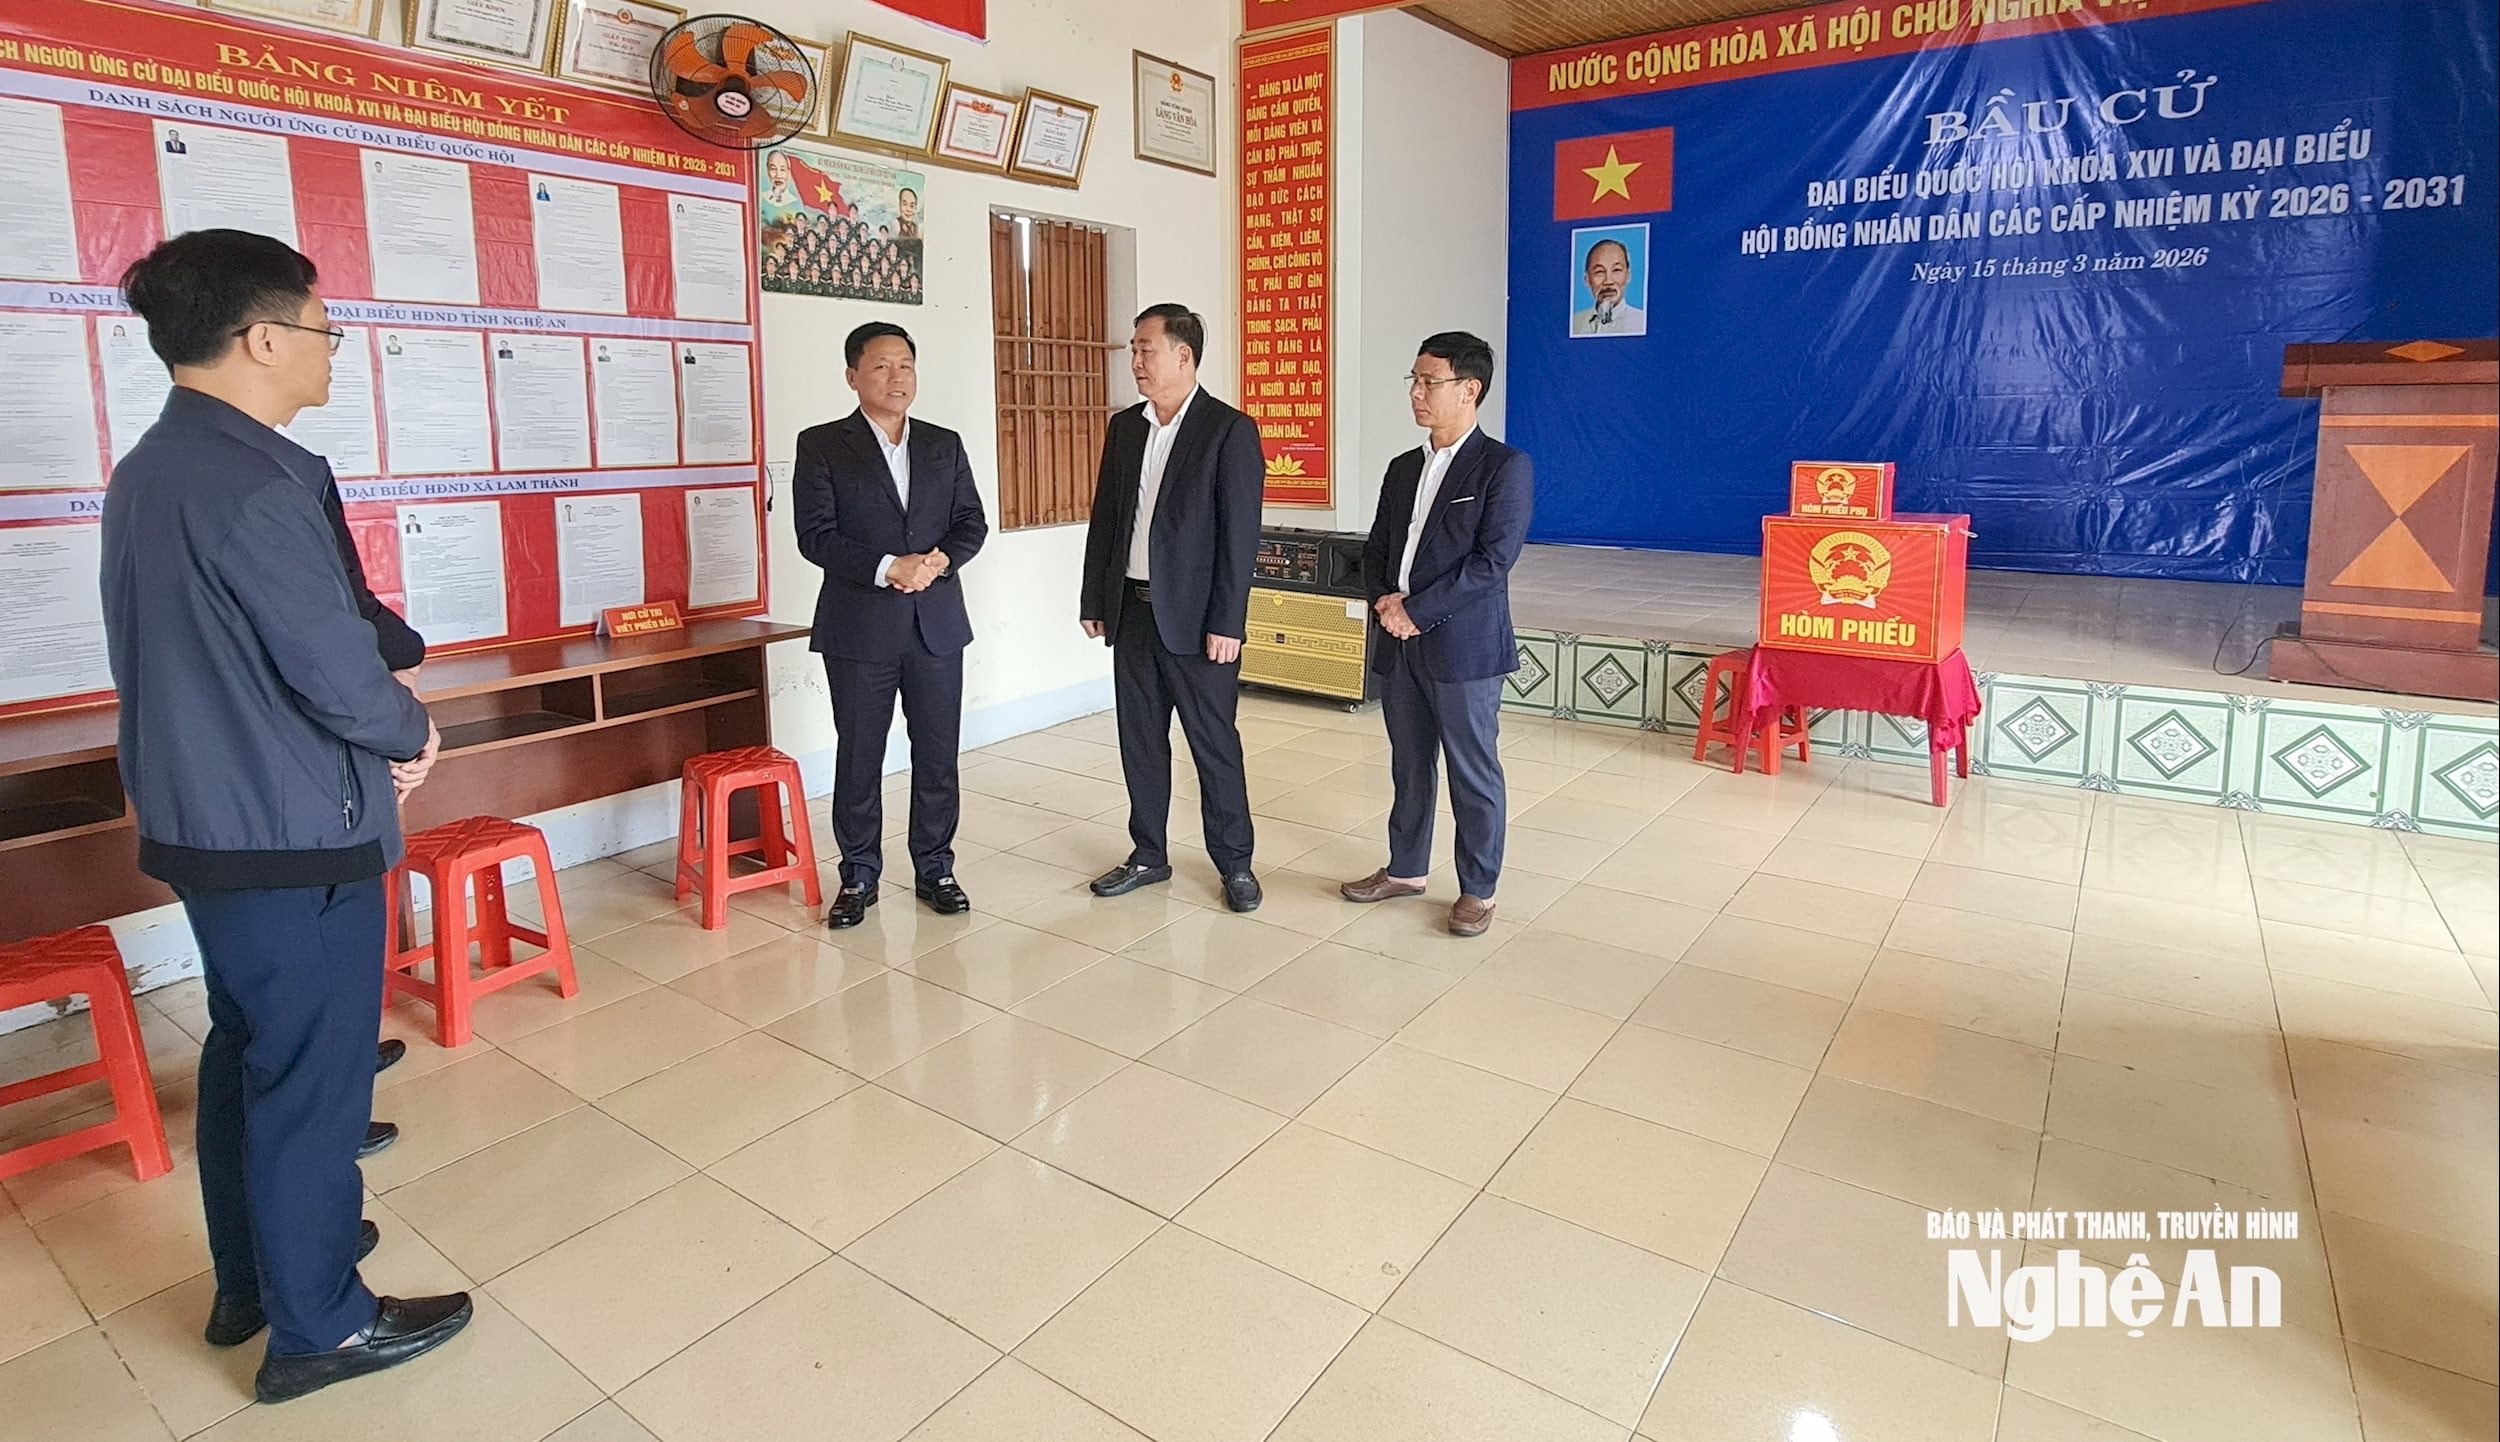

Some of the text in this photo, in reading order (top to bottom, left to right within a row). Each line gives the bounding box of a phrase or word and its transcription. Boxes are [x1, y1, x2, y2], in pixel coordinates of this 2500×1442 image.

[1548, 51, 1618, 92] NƯỚC
[1626, 41, 1701, 84] CỘNG
[1709, 26, 1768, 69] HÒA
[1776, 15, 1818, 58] XÃ
[1827, 6, 1881, 53] HỘI
[215, 43, 570, 125] BẢNG NIÊM YẾT
[1259, 71, 1324, 98] ĐẢNG TA LÀ MỘT
[24, 42, 84, 70] NGƯỜI
[89, 50, 128, 78] ỨNG
[133, 58, 157, 82] CỬ
[162, 66, 190, 90] ĐẠI
[195, 68, 233, 95] BIỂU
[238, 78, 279, 102] QUỐC
[284, 86, 310, 110] HỘI
[357, 99, 379, 118] XVI
[382, 102, 402, 122] VÀ
[404, 107, 427, 128] ĐẠI
[430, 109, 461, 131] BIỂU
[463, 116, 485, 138] HỘI
[487, 119, 521, 142] ĐỒNG
[523, 126, 557, 149] NHÂN
[559, 132, 583, 153] DÂN
[585, 136, 609, 157] CÁC
[610, 140, 631, 160] CẤP
[632, 147, 666, 169] NHIỆM
[668, 152, 681, 169] KỲ
[682, 156, 707, 173] 2026
[714, 162, 736, 178] 2031
[1246, 103, 1267, 123] ĐẢNG
[1922, 68, 2218, 145] BẦU CỬ
[88, 88, 151, 109] DANH
[157, 98, 213, 118] SÁCH
[219, 104, 283, 129] NGƯỜI
[289, 116, 328, 136] ỨNG
[333, 124, 358, 139] CỬ
[397, 134, 436, 151] BIỂU
[440, 139, 484, 159] QUỐC
[487, 148, 515, 164] HỘI
[1264, 115, 1323, 141] ĐẢNG VIÊN VÀ
[1246, 139, 1323, 165] CÁN BỘ PHẢI THỰC
[1246, 170, 1258, 189] SỰ
[1263, 164, 1286, 185] THẤM
[1807, 118, 2373, 212] ĐẠI BIỂU QUỐC HỘI KHÓA XVI VÀ ĐẠI BIỂU
[1246, 183, 1323, 210] ĐẠO ĐỨC CÁCH
[1246, 206, 1324, 231] MẠNG, THẬT SỰ
[1741, 173, 2466, 259] HỘI ĐỒNG NHÂN DÂN CÁC CẤP NHIỆM KỲ 2026 2031
[1270, 227, 1323, 250] KIỆM, LIÊM,
[1247, 249, 1323, 271] CHÍNH, CHÍ CÔNG VÔ
[1910, 247, 2210, 283] Ngày 15 tháng 3 năm 2026
[1263, 271, 1323, 291] PHẢI GIỮ GÌN
[49, 291, 113, 306] DANH
[1247, 292, 1323, 313] ĐẢNG TA THẬT
[331, 305, 360, 319] ĐẠI
[366, 304, 406, 320] BIỂU
[461, 310, 498, 325] TỈNH
[503, 314, 544, 329] NGHỆ
[547, 319, 567, 328] AN
[1247, 312, 1322, 336] TRONG SẠCH, PHẢI
[1246, 335, 1322, 355] XỨNG ĐÁNG LÀ
[1246, 358, 1322, 377] NGƯỜI LÃNH ĐẠO,
[1260, 378, 1322, 396] NGƯỜI TỚ
[1246, 400, 1322, 419] THẬT TRUNG THÀNH
[1262, 421, 1284, 438] NHÂN
[345, 487, 376, 499] ĐẠI
[381, 480, 420, 497] BIỂU
[473, 480, 493, 492] XÃ
[497, 480, 528, 491] LAM
[530, 477, 579, 489] THÀNH
[1801, 502, 1868, 517] HÒM PHIẾU PHỤ
[615, 618, 659, 634] VIẾT PHIẾU
[621, 607, 663, 622] NƠI CỬ TRI
[1780, 609, 1916, 647] HÒM PHIẾU
